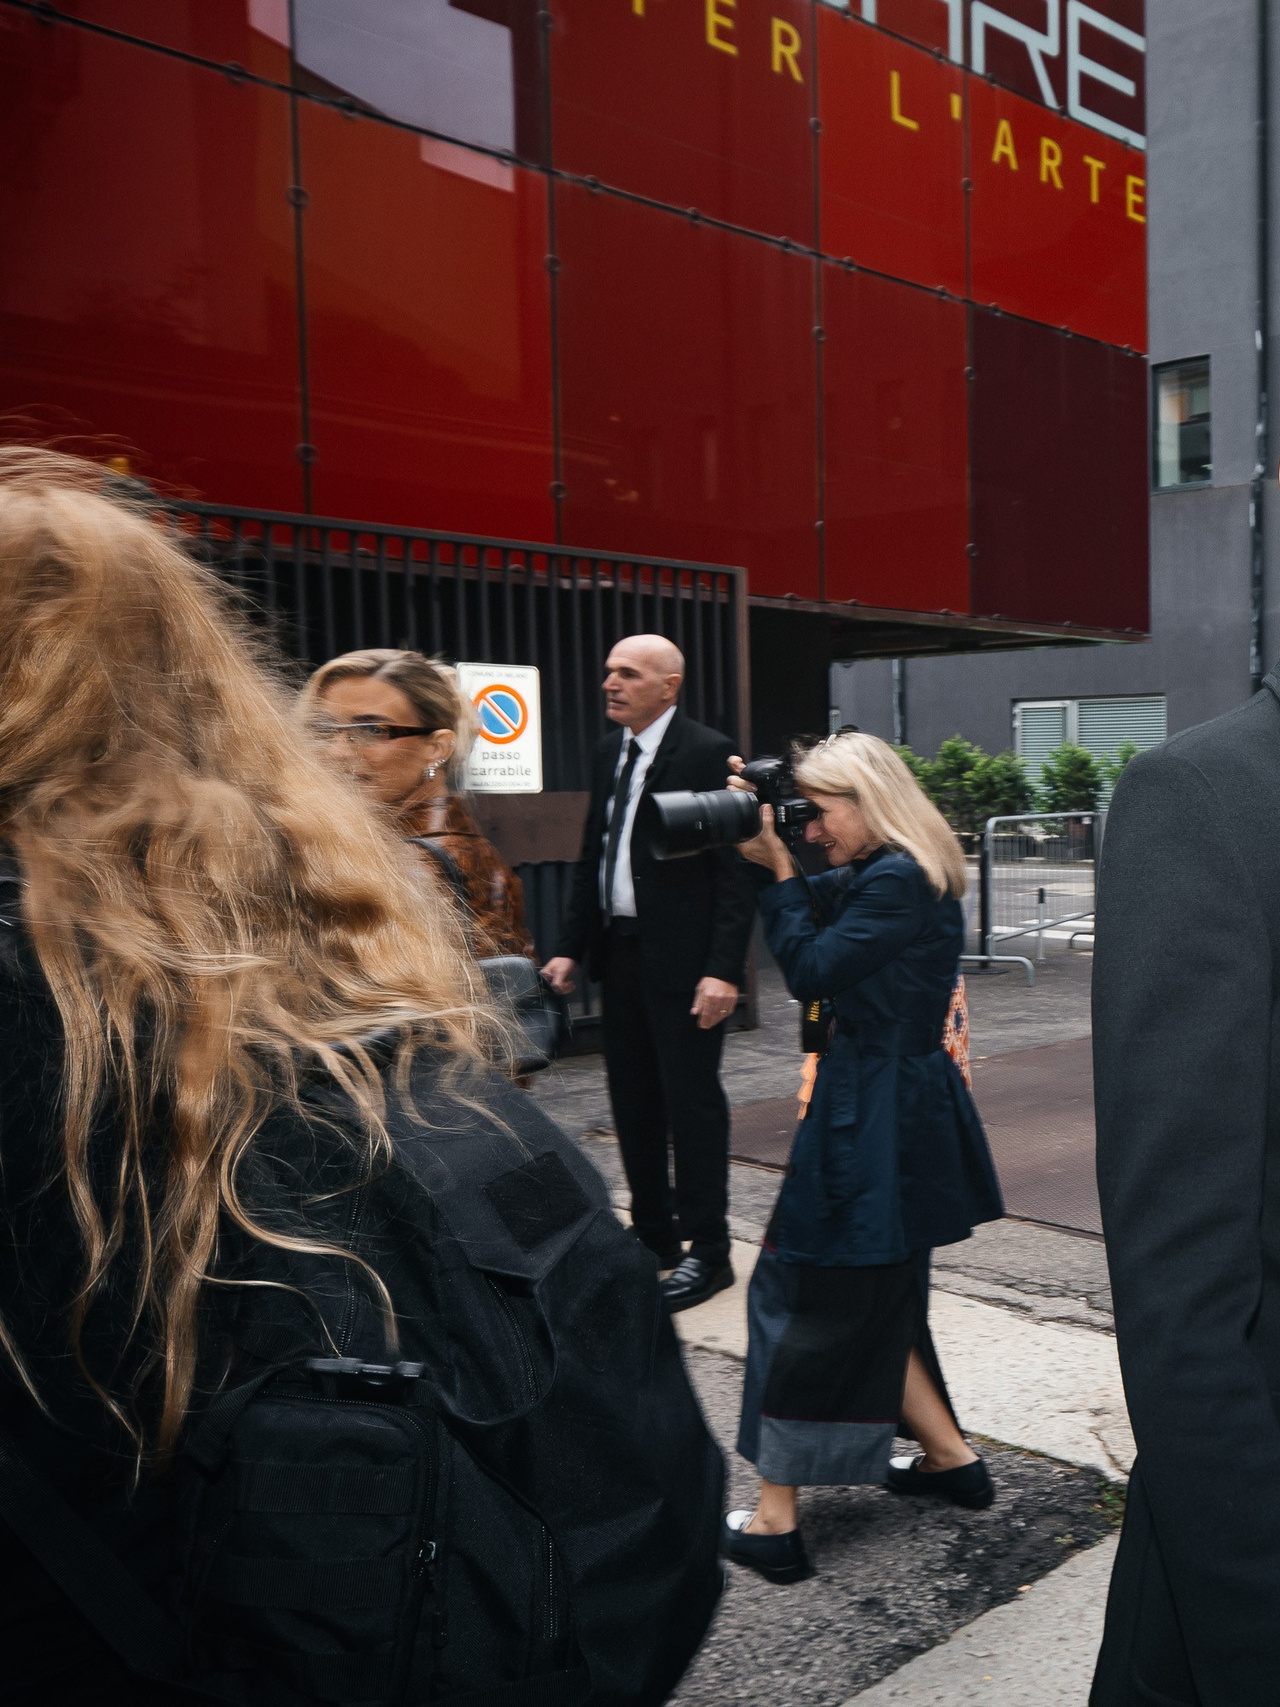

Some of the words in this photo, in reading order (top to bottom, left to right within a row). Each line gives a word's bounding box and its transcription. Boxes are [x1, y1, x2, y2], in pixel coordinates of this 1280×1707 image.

[631, 0, 804, 83] ER
[890, 70, 1146, 223] L'ARTE
[482, 751, 521, 761] passo
[471, 764, 532, 776] carrabile
[809, 1000, 820, 1022] Niko
